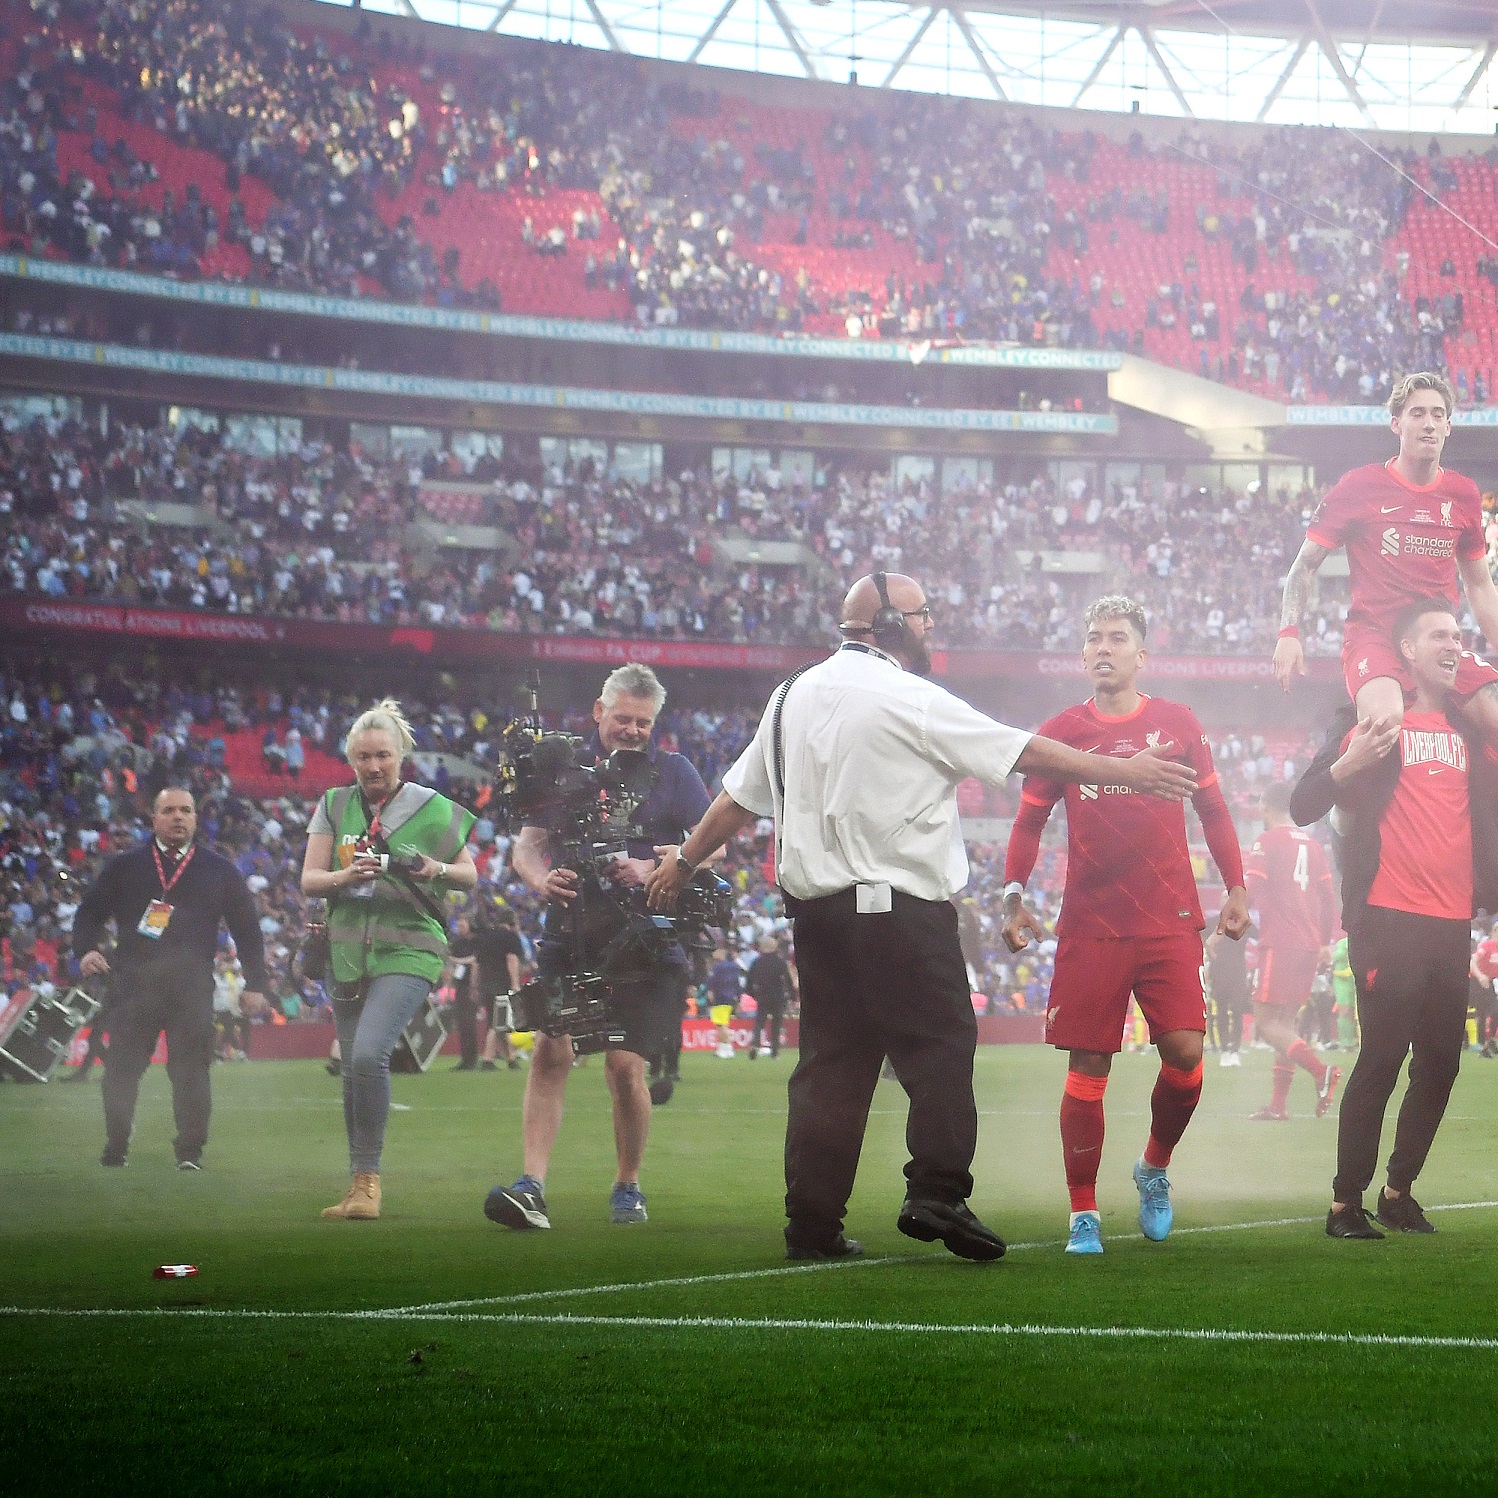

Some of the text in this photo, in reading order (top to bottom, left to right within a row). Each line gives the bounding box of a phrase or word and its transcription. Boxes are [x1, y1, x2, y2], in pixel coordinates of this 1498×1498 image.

[951, 348, 1121, 367] WEMBLEY CONNECTED
[1022, 415, 1096, 429] WEMBLEY
[1292, 410, 1370, 422] WEMBLEY
[1475, 410, 1493, 422] BY
[1405, 534, 1454, 548] standard
[1404, 545, 1453, 557] chartered
[186, 618, 269, 640] LIVERPOOL
[631, 644, 661, 660] CUP
[1293, 844, 1309, 892] 4
